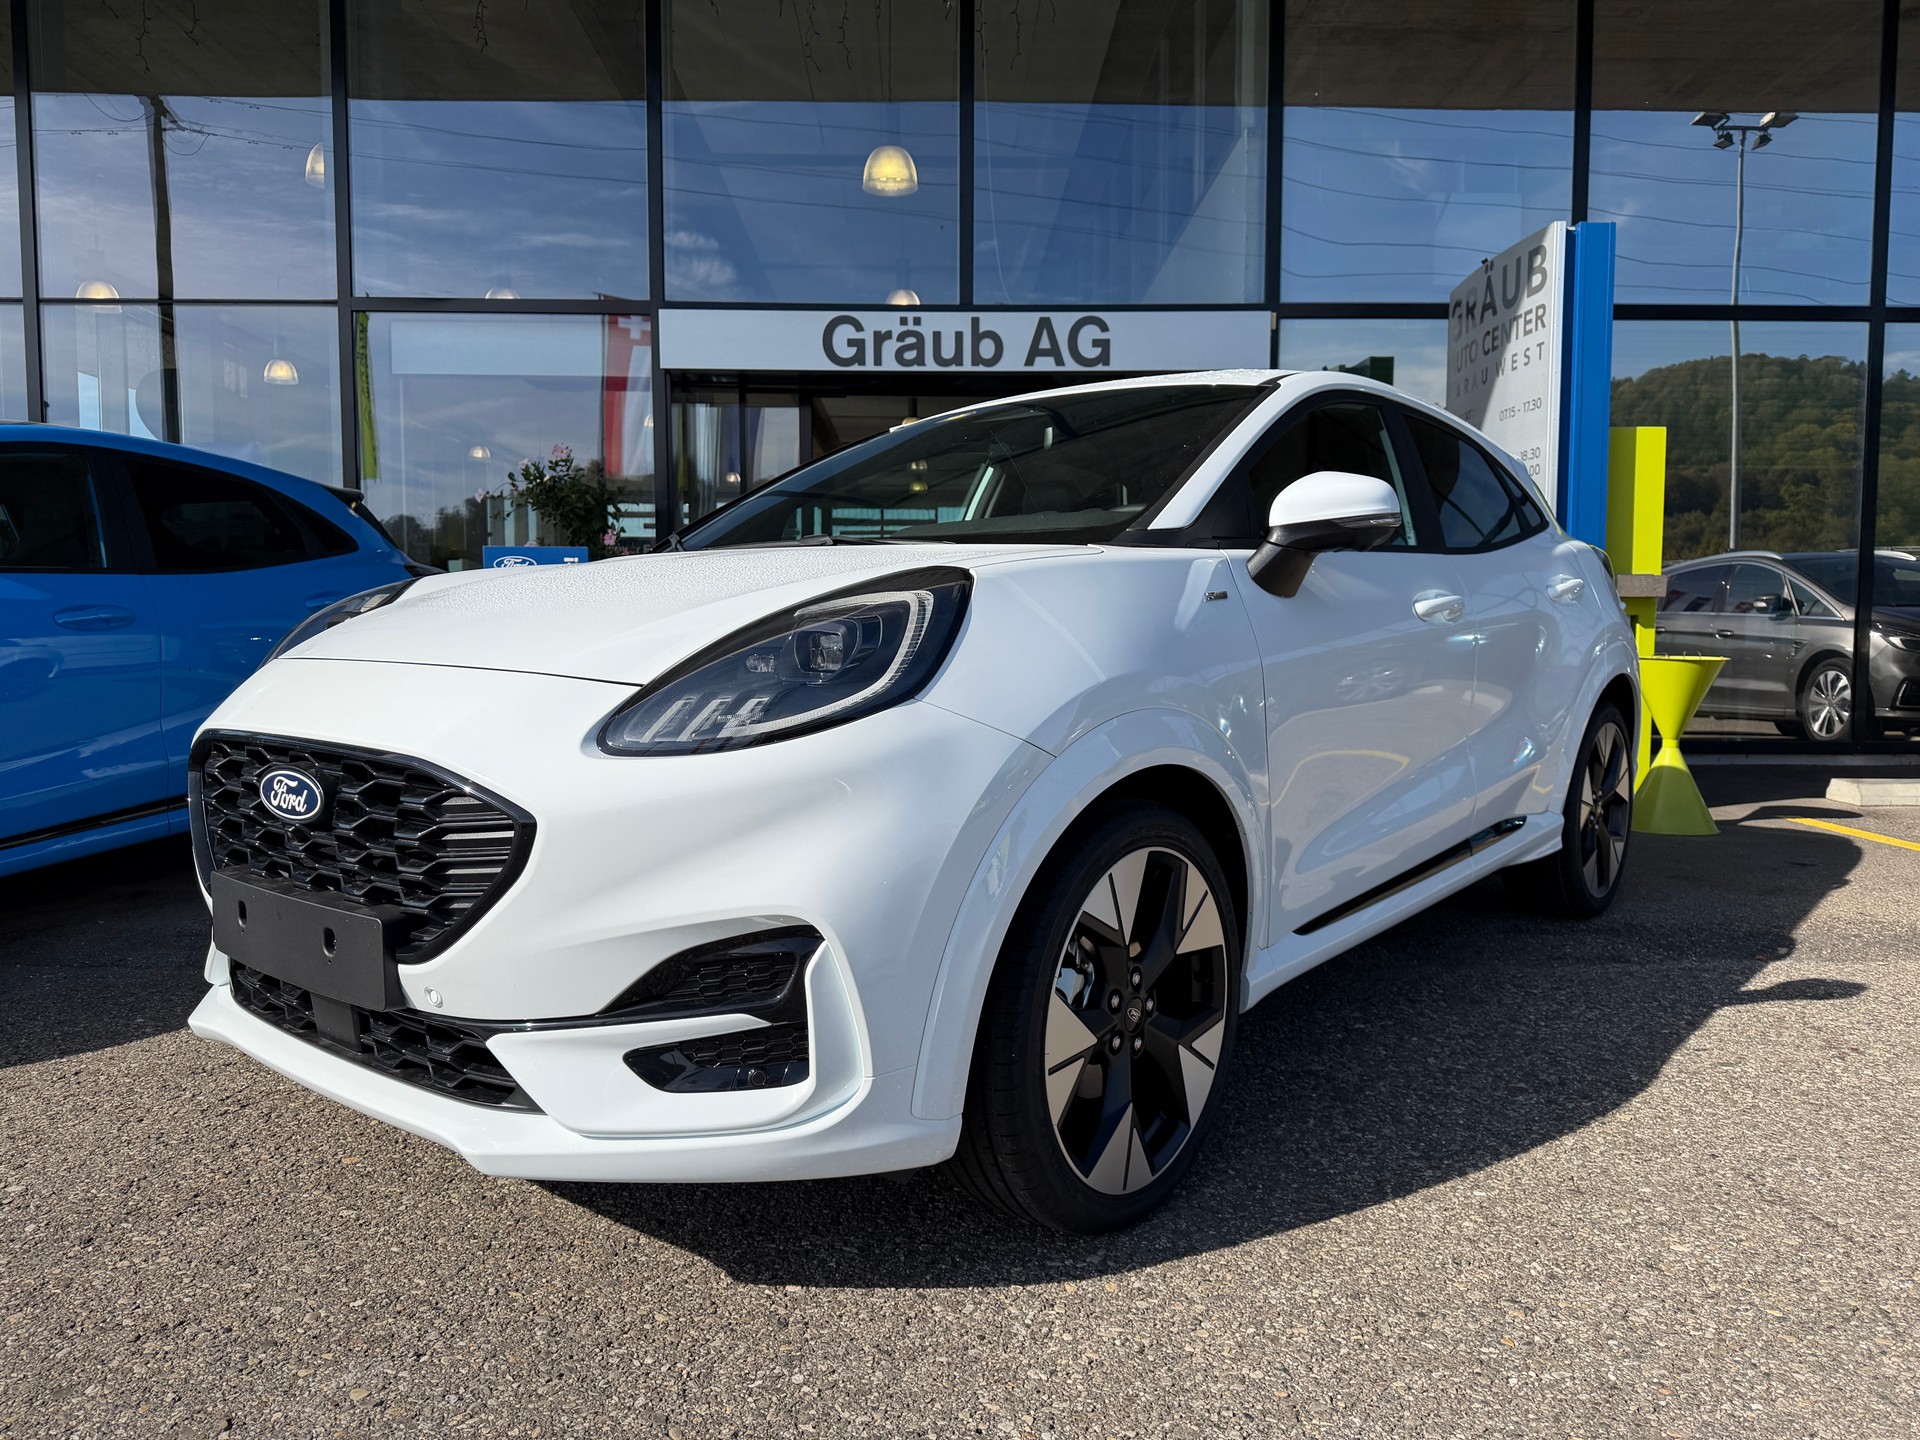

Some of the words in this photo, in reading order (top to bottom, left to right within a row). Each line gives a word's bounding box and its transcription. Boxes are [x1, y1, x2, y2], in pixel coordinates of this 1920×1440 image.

[1451, 244, 1548, 343] GRÄUB
[822, 315, 1004, 367] Gräub
[1024, 315, 1111, 367] AG
[1453, 338, 1479, 374] UTO
[1482, 303, 1546, 356] CENTER
[1496, 342, 1545, 377] WEST
[1523, 397, 1542, 413] 17.30
[270, 776, 308, 813] Ford
